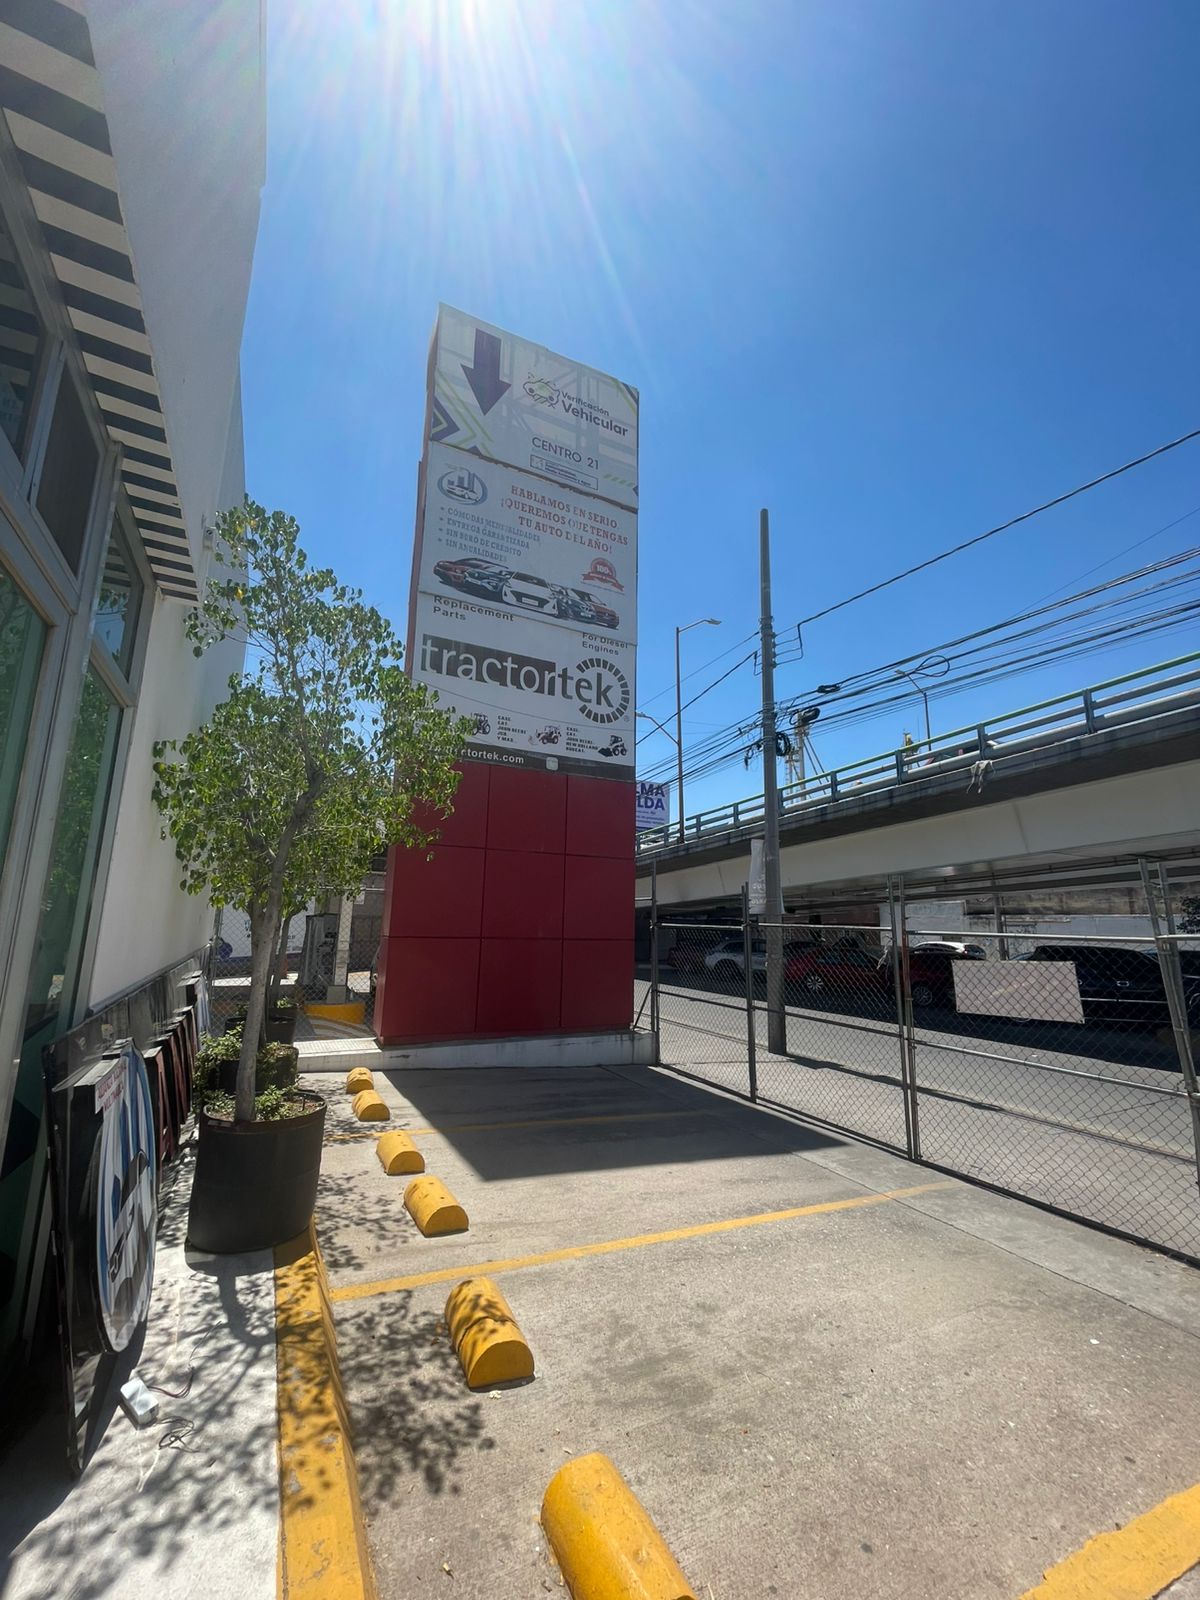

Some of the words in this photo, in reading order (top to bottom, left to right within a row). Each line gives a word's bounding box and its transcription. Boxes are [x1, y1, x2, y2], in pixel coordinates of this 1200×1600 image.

[562, 392, 609, 416] Verificación
[562, 400, 628, 436] Vehicular
[532, 436, 582, 462] CENTRO
[587, 457, 598, 470] 21
[511, 485, 570, 512] HABLAMOS
[574, 506, 586, 518] EN
[588, 512, 618, 528] SERIO
[501, 498, 566, 524] ¡QUEREMOS
[589, 526, 628, 546] TENGAS
[518, 516, 532, 528] TU
[534, 522, 562, 538] AUTO
[565, 531, 586, 546] DEL
[433, 606, 466, 620] Parts
[434, 596, 514, 621] Replacement
[582, 632, 597, 641] For
[600, 636, 628, 648] Diesel
[582, 641, 619, 656] Engines
[422, 639, 614, 708] tractortek
[636, 796, 665, 810] LDA
